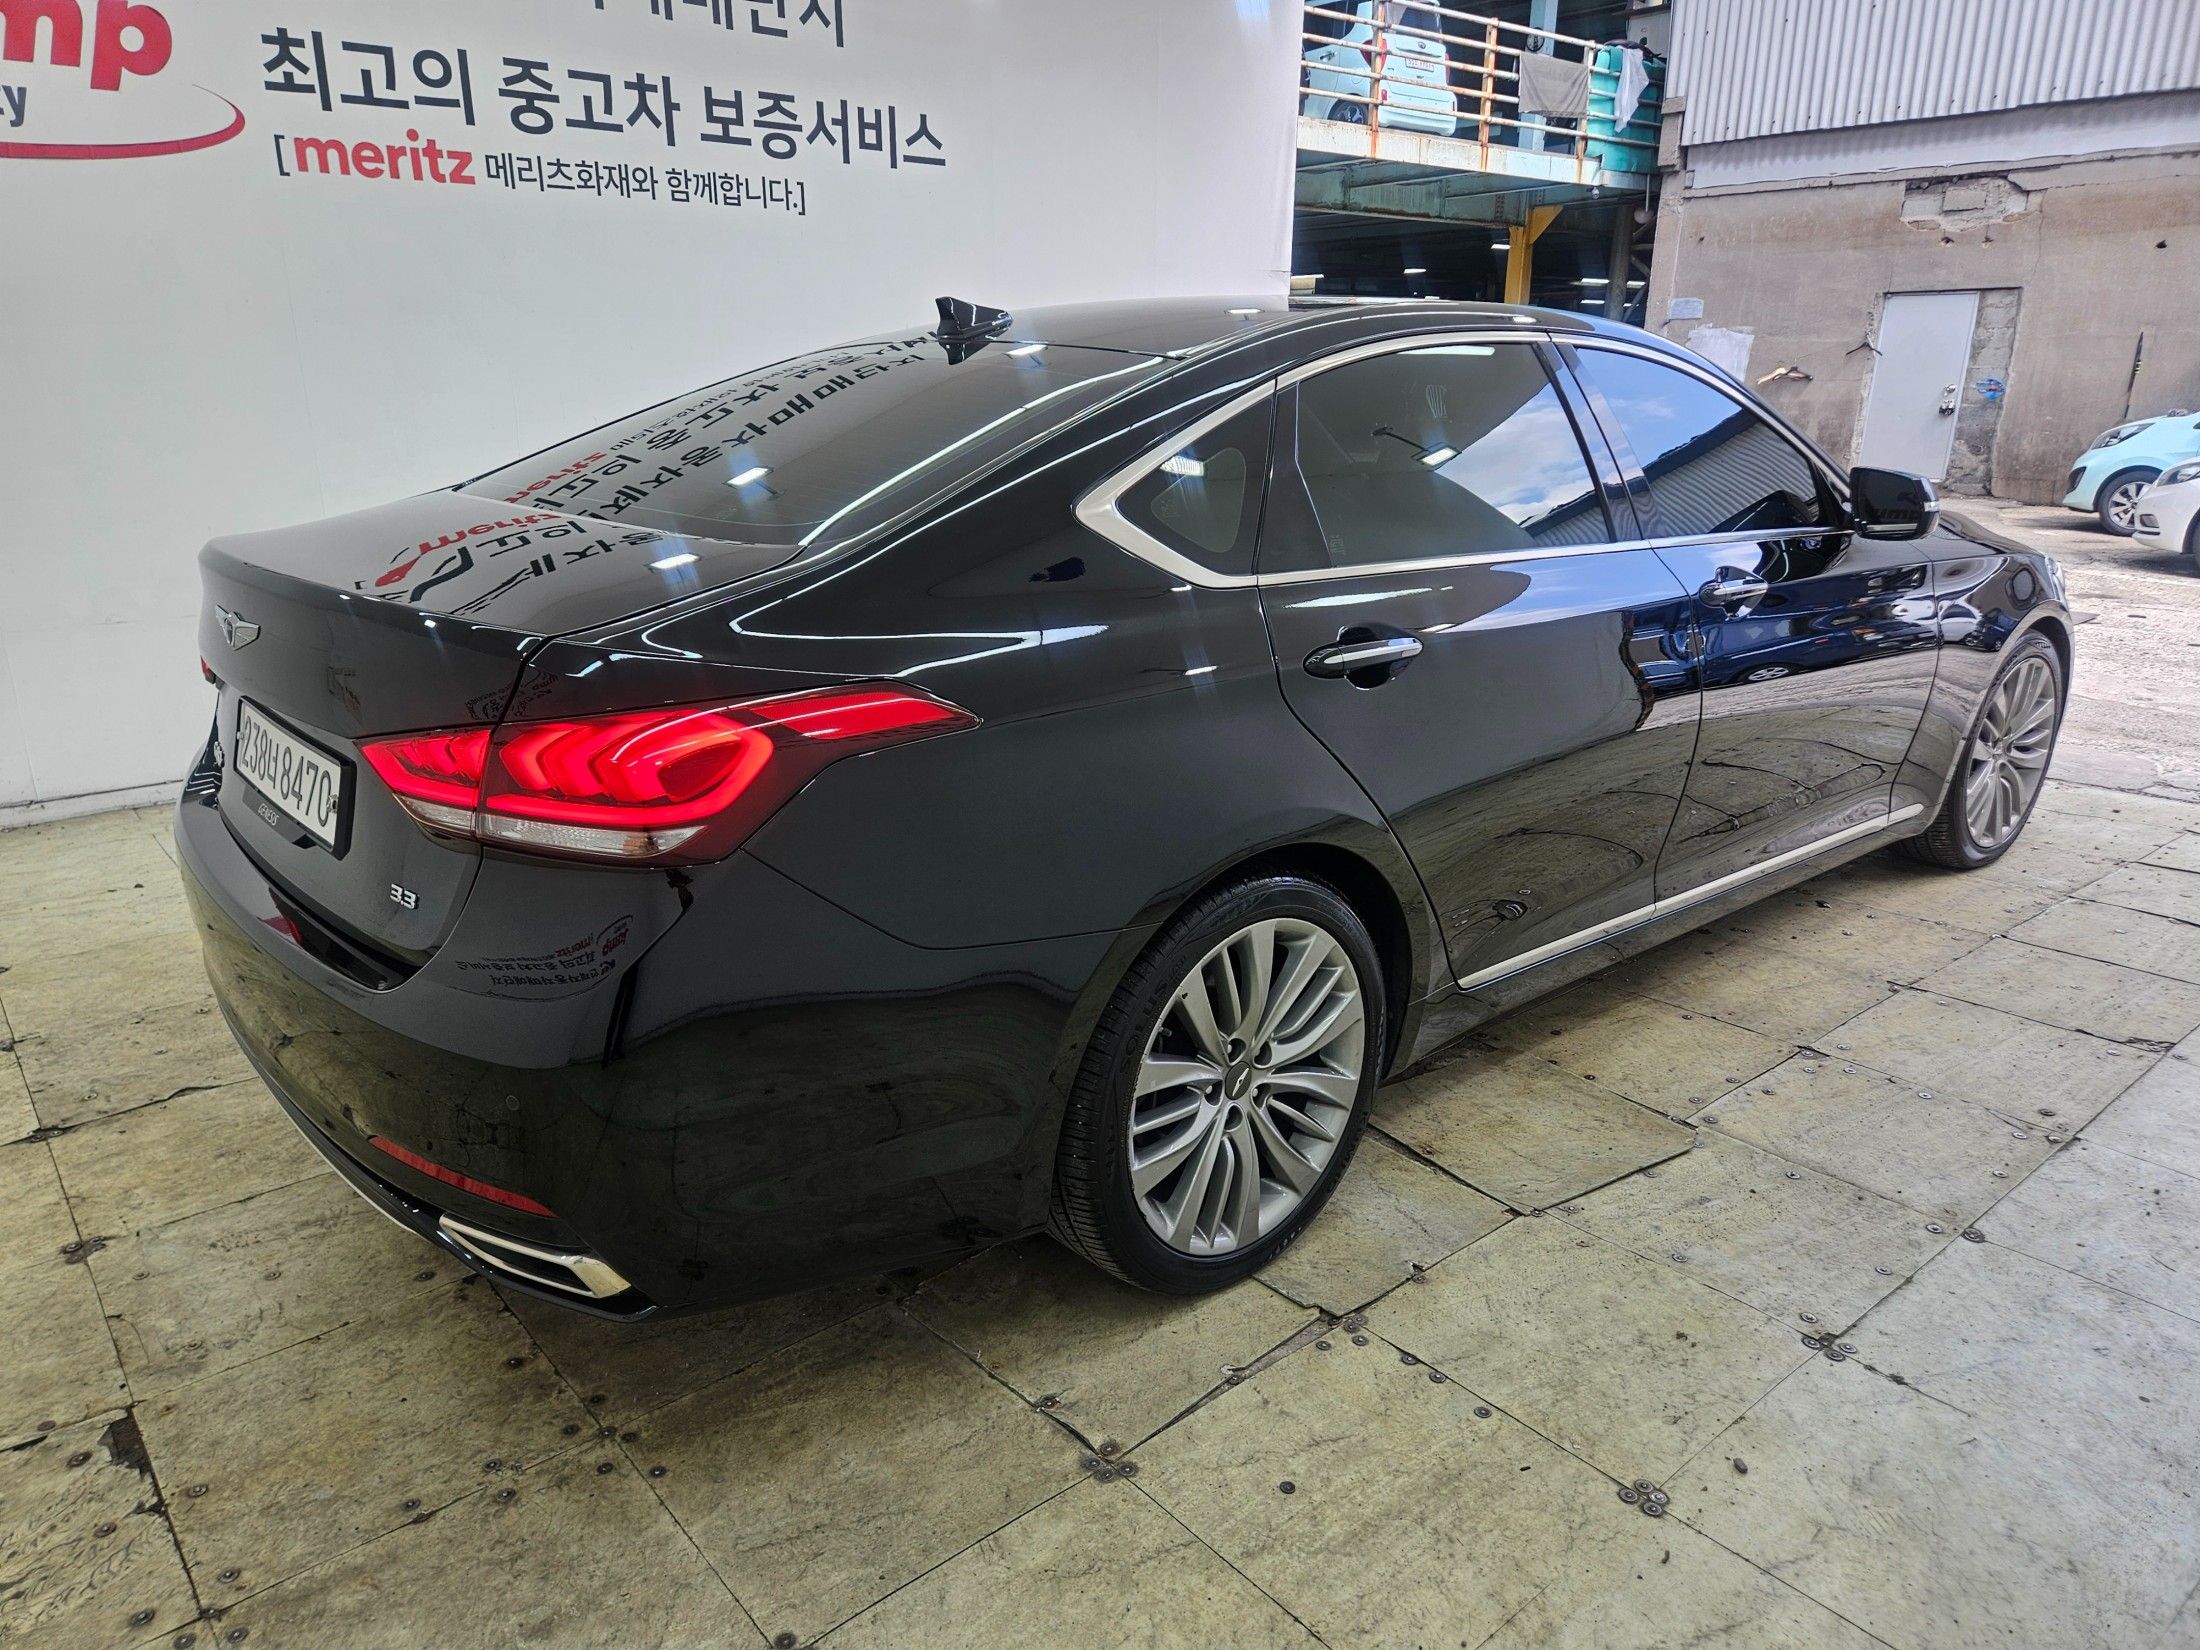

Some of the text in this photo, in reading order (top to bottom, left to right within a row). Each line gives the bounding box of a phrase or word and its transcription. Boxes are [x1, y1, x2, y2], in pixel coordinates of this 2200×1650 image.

[261, 27, 946, 169] 최고의 중고차 보증서비스
[485, 152, 658, 200] 메리츠화재와
[665, 167, 806, 216] 함께합니다.]
